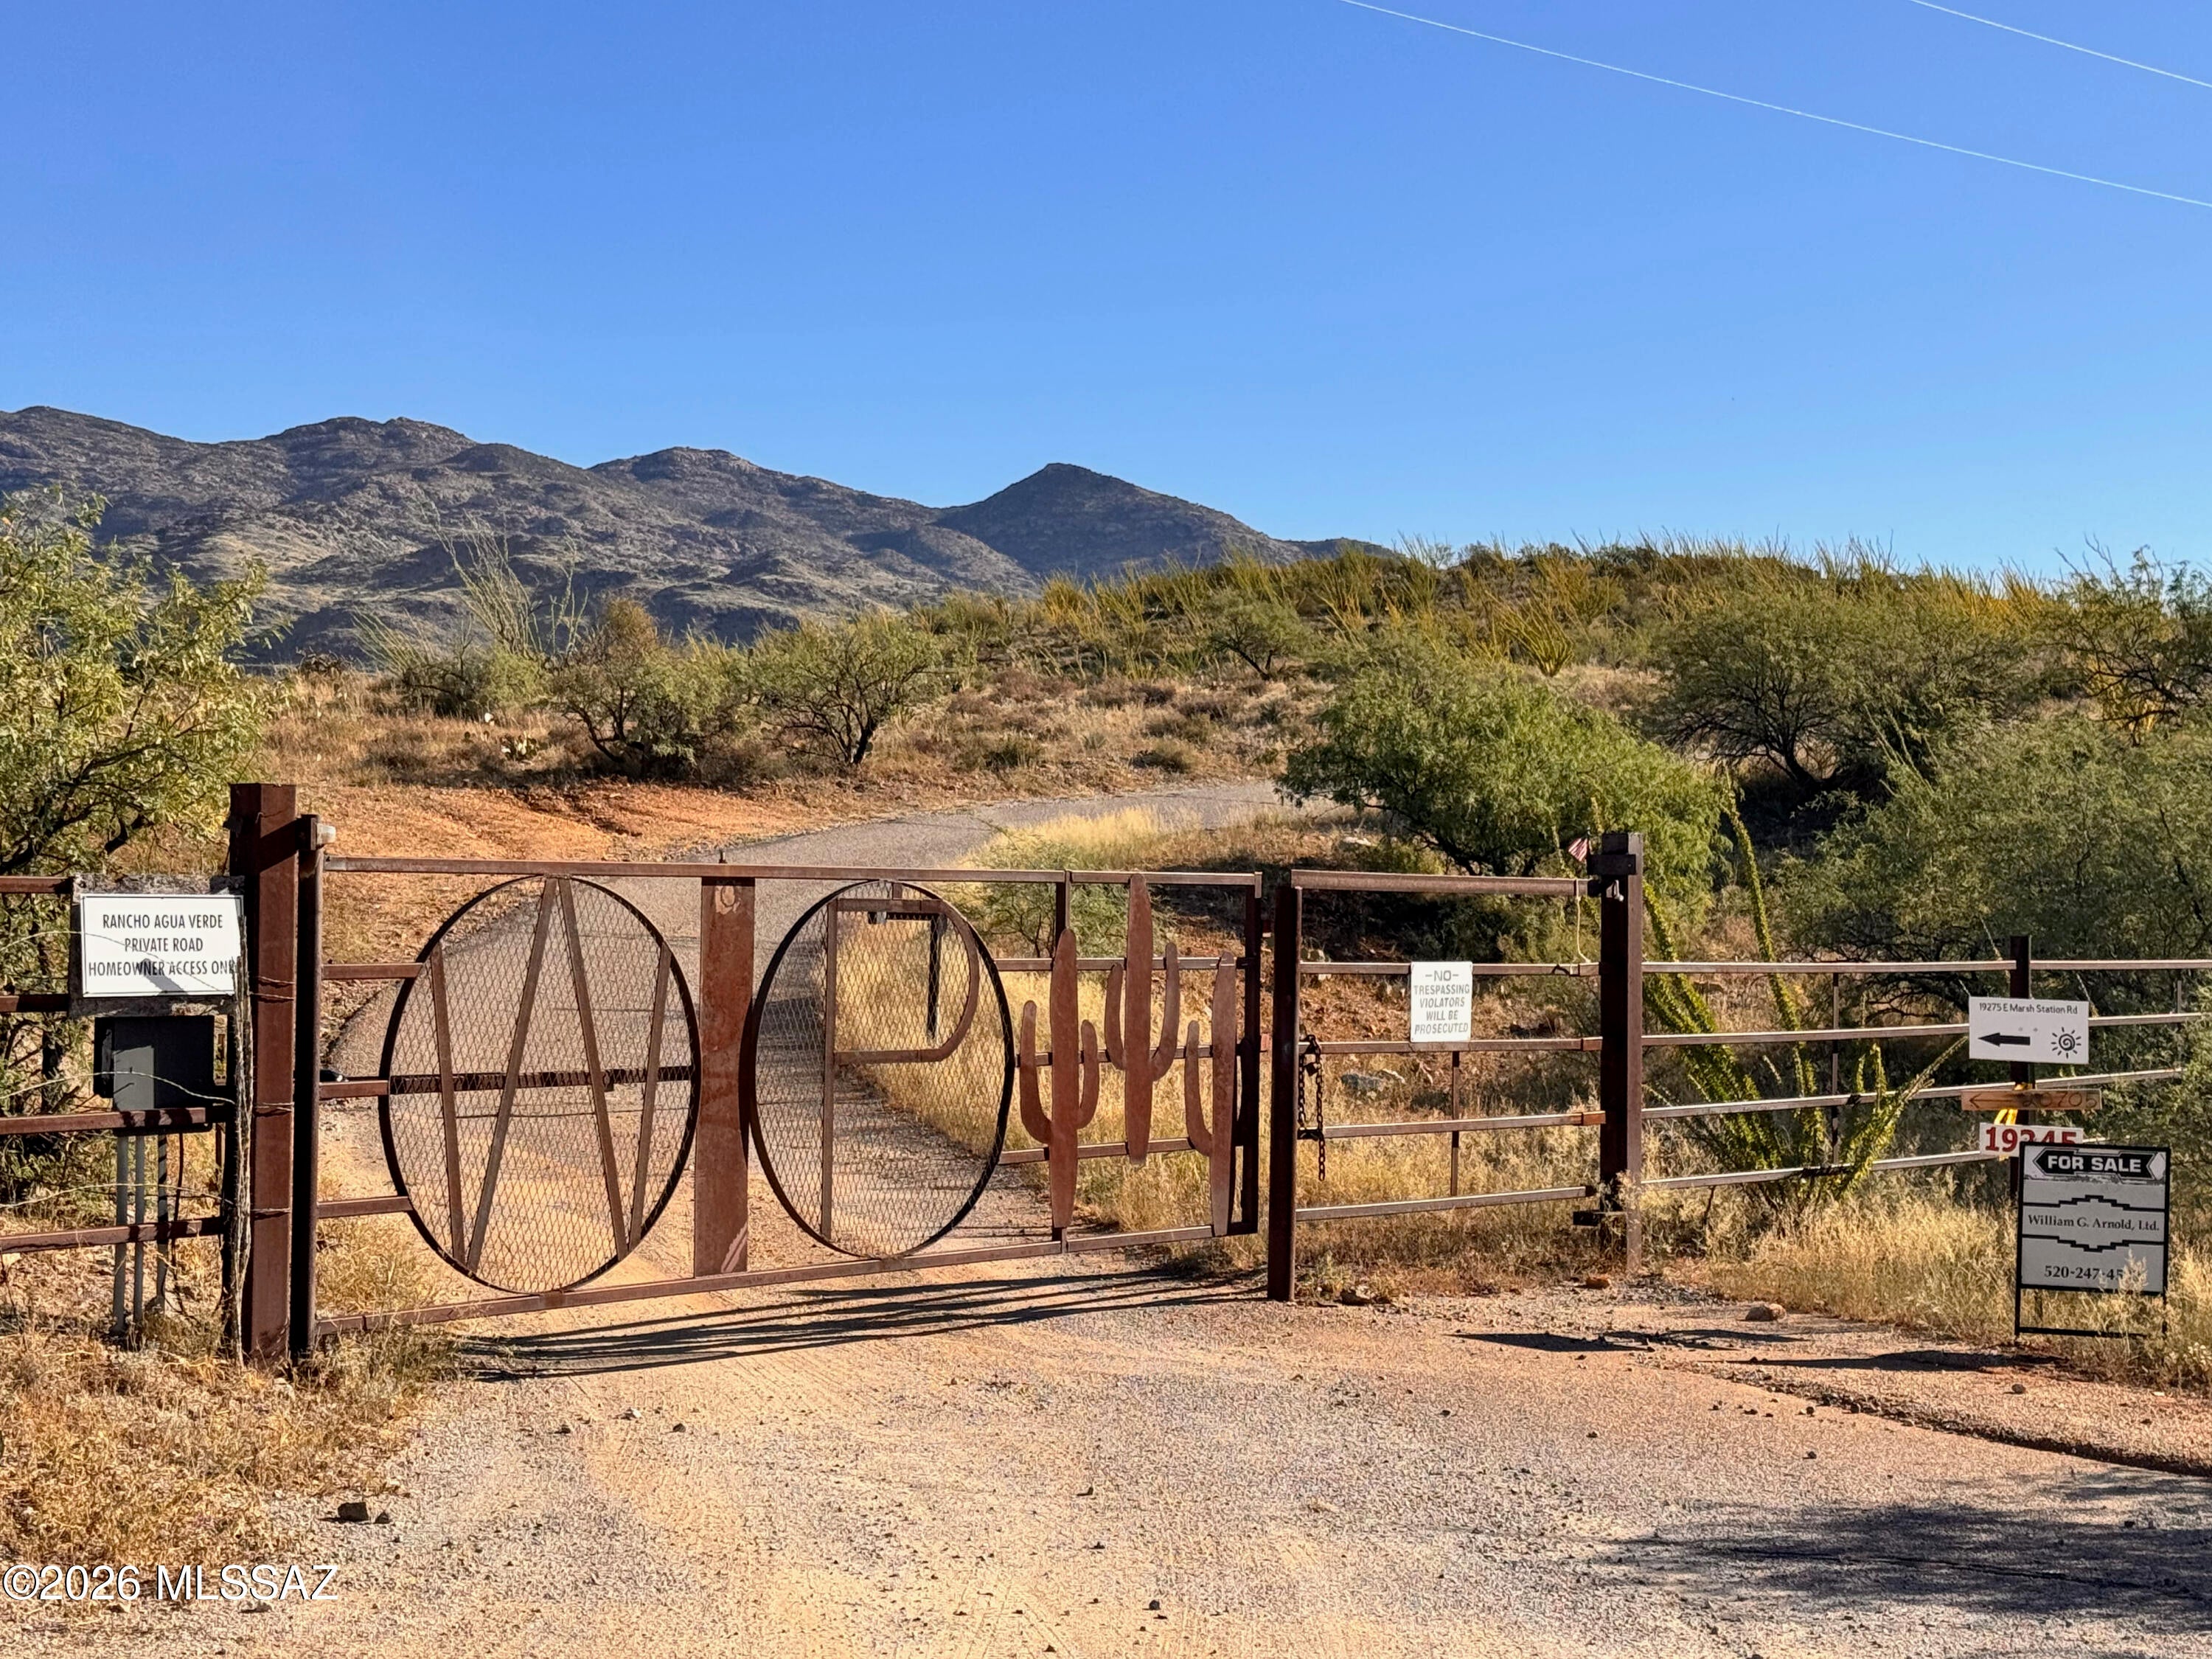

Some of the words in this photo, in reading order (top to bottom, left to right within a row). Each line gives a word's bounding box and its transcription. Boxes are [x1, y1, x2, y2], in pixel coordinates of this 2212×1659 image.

[102, 914, 150, 928] RANCHO
[154, 914, 185, 928] AGUA
[189, 914, 223, 928] VERDE
[125, 938, 169, 951] PRIVATE
[173, 938, 204, 951] ROAD
[88, 961, 164, 976] HOMEOWNER
[169, 961, 207, 975] ACCESS
[1413, 984, 1470, 995] TRESPASSING
[1420, 997, 1464, 1008] VIOLATORS
[1979, 1003, 2003, 1012] 19275
[2003, 1004, 2008, 1012] E
[2010, 1004, 2034, 1012] Marsh
[2037, 1004, 2066, 1014] Station
[2067, 1005, 2078, 1014] Rd
[1426, 1010, 1445, 1020] WILL
[1448, 1010, 1458, 1020] BE
[1414, 1023, 1469, 1034] PROSECUTED
[2048, 1155, 2084, 1170] FOR
[2091, 1157, 2141, 1172] SALE
[2028, 1214, 2074, 1227] William
[2076, 1217, 2090, 1228] G.
[2093, 1218, 2135, 1231] Arnold,
[2138, 1220, 2160, 1231] Ltd.
